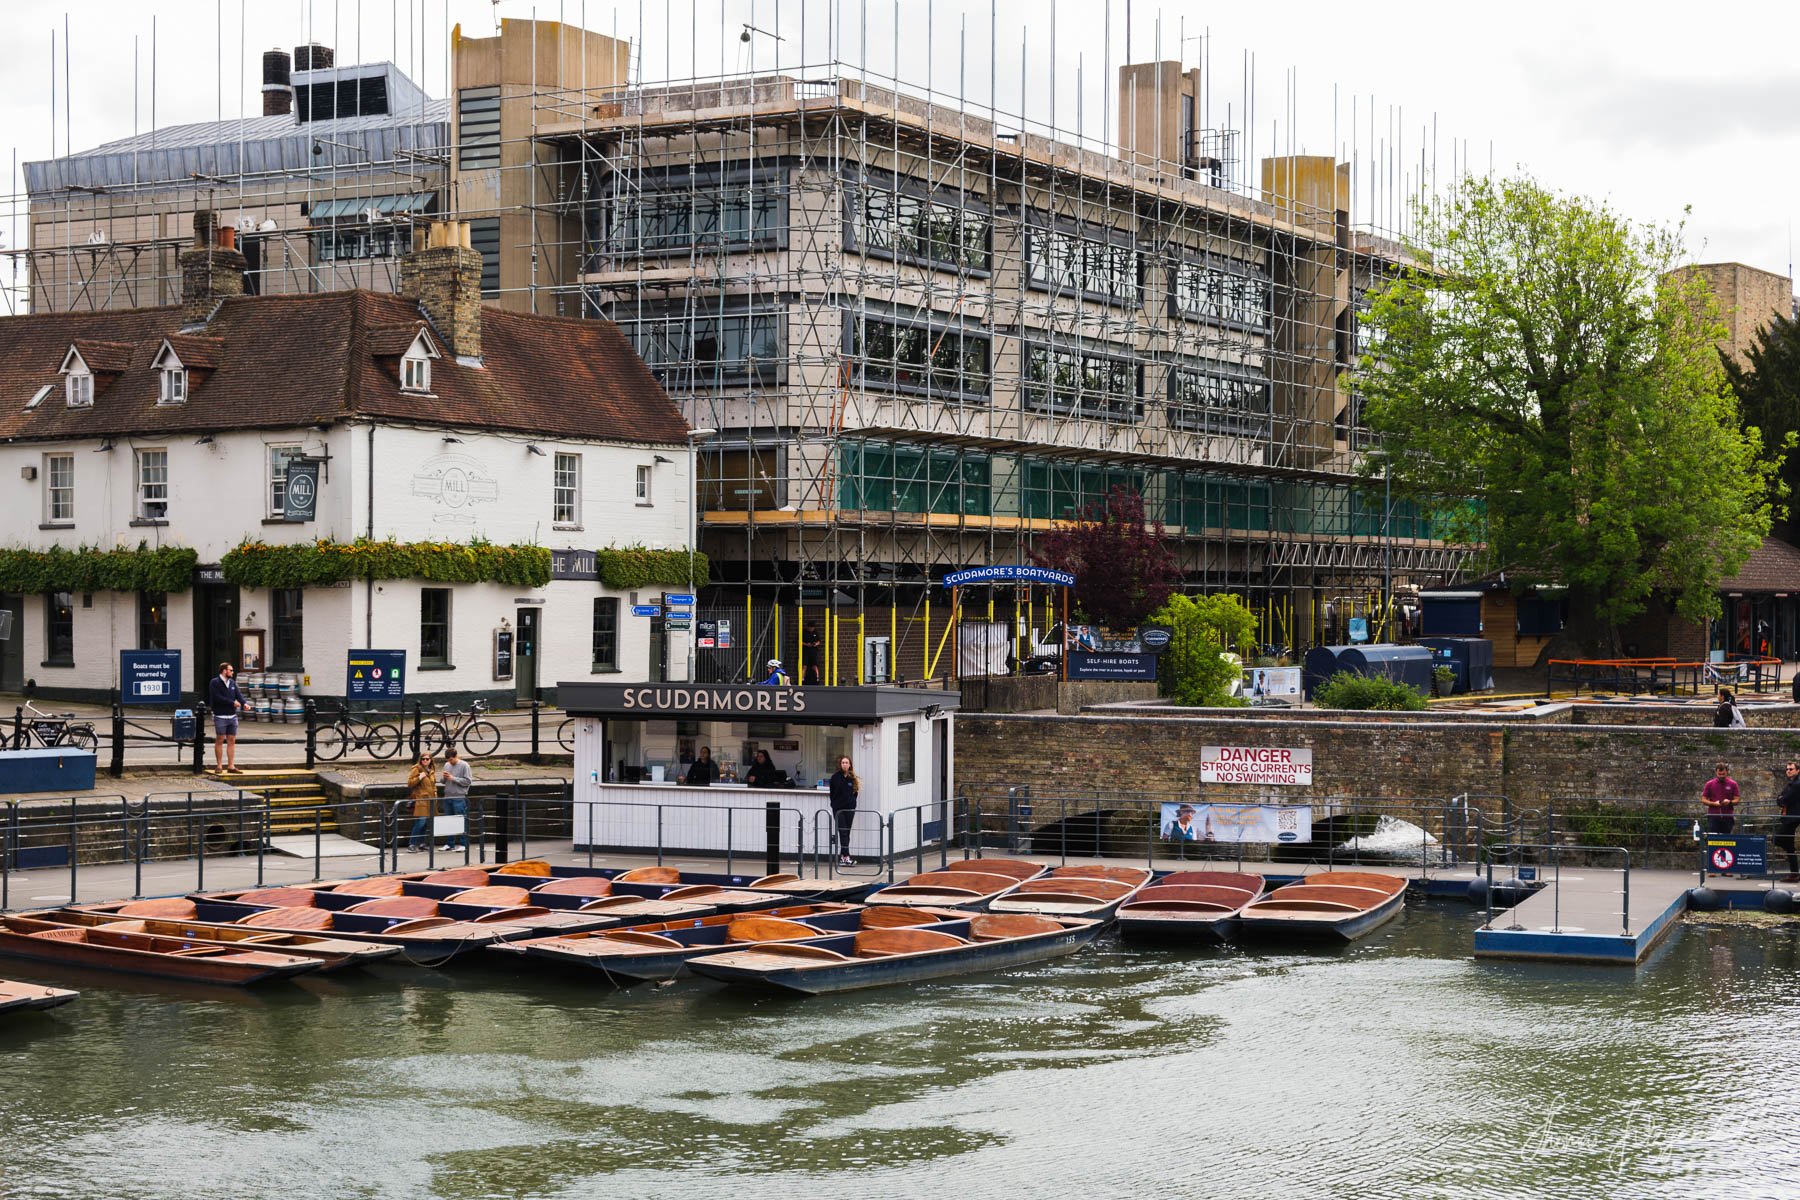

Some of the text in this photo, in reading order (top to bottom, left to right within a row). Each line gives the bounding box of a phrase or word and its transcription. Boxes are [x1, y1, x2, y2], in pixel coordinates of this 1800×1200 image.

[291, 484, 312, 495] MILL
[444, 480, 465, 493] MILL
[551, 557, 598, 573] HE MILL
[200, 571, 212, 579] THE
[945, 567, 1074, 585] SCUDAMORE'S BOATYARDS
[143, 684, 161, 692] 1930
[623, 688, 806, 712] SCUDAMORE'S
[1220, 748, 1291, 763] DANGER
[1201, 761, 1311, 774] STRONG CURRENTS
[1216, 772, 1296, 784] NO SWIMMING
